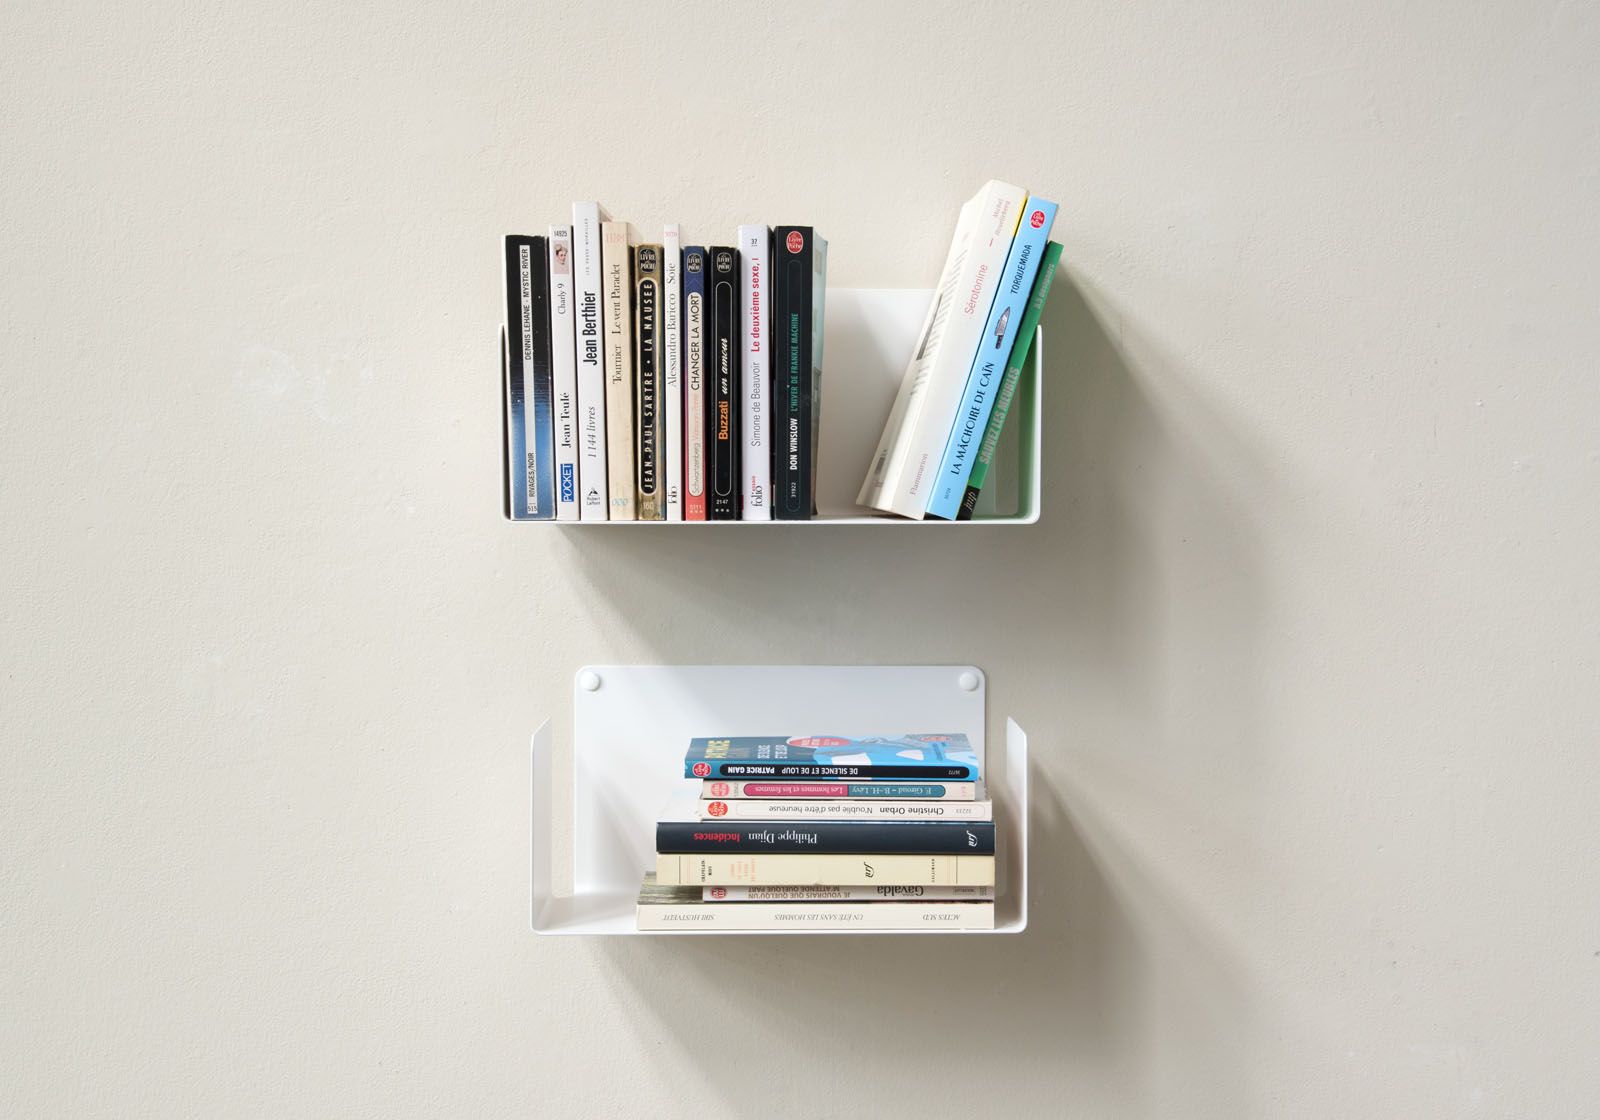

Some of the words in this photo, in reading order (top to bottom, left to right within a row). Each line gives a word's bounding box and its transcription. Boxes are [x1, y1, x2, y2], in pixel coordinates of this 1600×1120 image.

[611, 264, 620, 299] Paraclet
[666, 263, 675, 284] Soie
[752, 263, 760, 288] sexe,
[557, 291, 567, 315] Charly
[581, 291, 597, 336] Berthier
[643, 284, 653, 330] NAUSEE
[667, 293, 676, 330] Baricco
[691, 294, 699, 322] MORT
[750, 291, 760, 336] deuxième
[611, 323, 621, 334] Le
[691, 326, 700, 338] LA
[583, 339, 597, 366] Jean
[643, 338, 653, 352] LA
[751, 341, 760, 352] Le
[612, 344, 622, 384] Tournier
[667, 334, 677, 387] Alessandro
[691, 341, 700, 390] CHANGER
[951, 463, 961, 475] LA
[956, 407, 981, 461] MÂCHOIRE
[974, 390, 985, 403] DE
[980, 362, 995, 387] CAÏN
[1011, 244, 1032, 294] TORQUEMADA
[721, 378, 728, 395] un
[750, 362, 760, 399] Beauvoir
[791, 375, 798, 384] DE
[910, 453, 928, 495] Flammarion
[964, 264, 988, 315] Sérotonine
[560, 392, 570, 421] Teulé
[643, 372, 653, 417] SARTRE
[751, 401, 760, 412] de
[791, 387, 799, 412] L'HIVER
[586, 406, 597, 432] livres
[719, 401, 729, 440] Buzzati
[980, 430, 996, 464] SAUVEZ
[992, 412, 1004, 429] LES
[998, 367, 1020, 411] MEUBLES
[561, 424, 571, 448] Jean
[751, 415, 761, 447] Simone
[790, 418, 798, 452] WINSLOW
[643, 423, 653, 489] JEAN-PAUL
[790, 454, 798, 470] DON
[527, 452, 536, 497] RIVAGES/NOIR
[562, 463, 573, 502] POCKET
[750, 485, 763, 507] folio
[832, 786, 843, 794] Les
[852, 786, 869, 794] Lévy
[926, 787, 932, 795] F.
[804, 805, 825, 813] d'être
[842, 806, 873, 814] N'oublie
[879, 807, 906, 815] Orban
[907, 807, 944, 815] Christine
[693, 832, 740, 842] Incidences
[748, 832, 775, 844] Djian
[777, 831, 817, 844] Philippe
[877, 886, 924, 896] Gavalda
[839, 914, 853, 922] ÉTÉ
